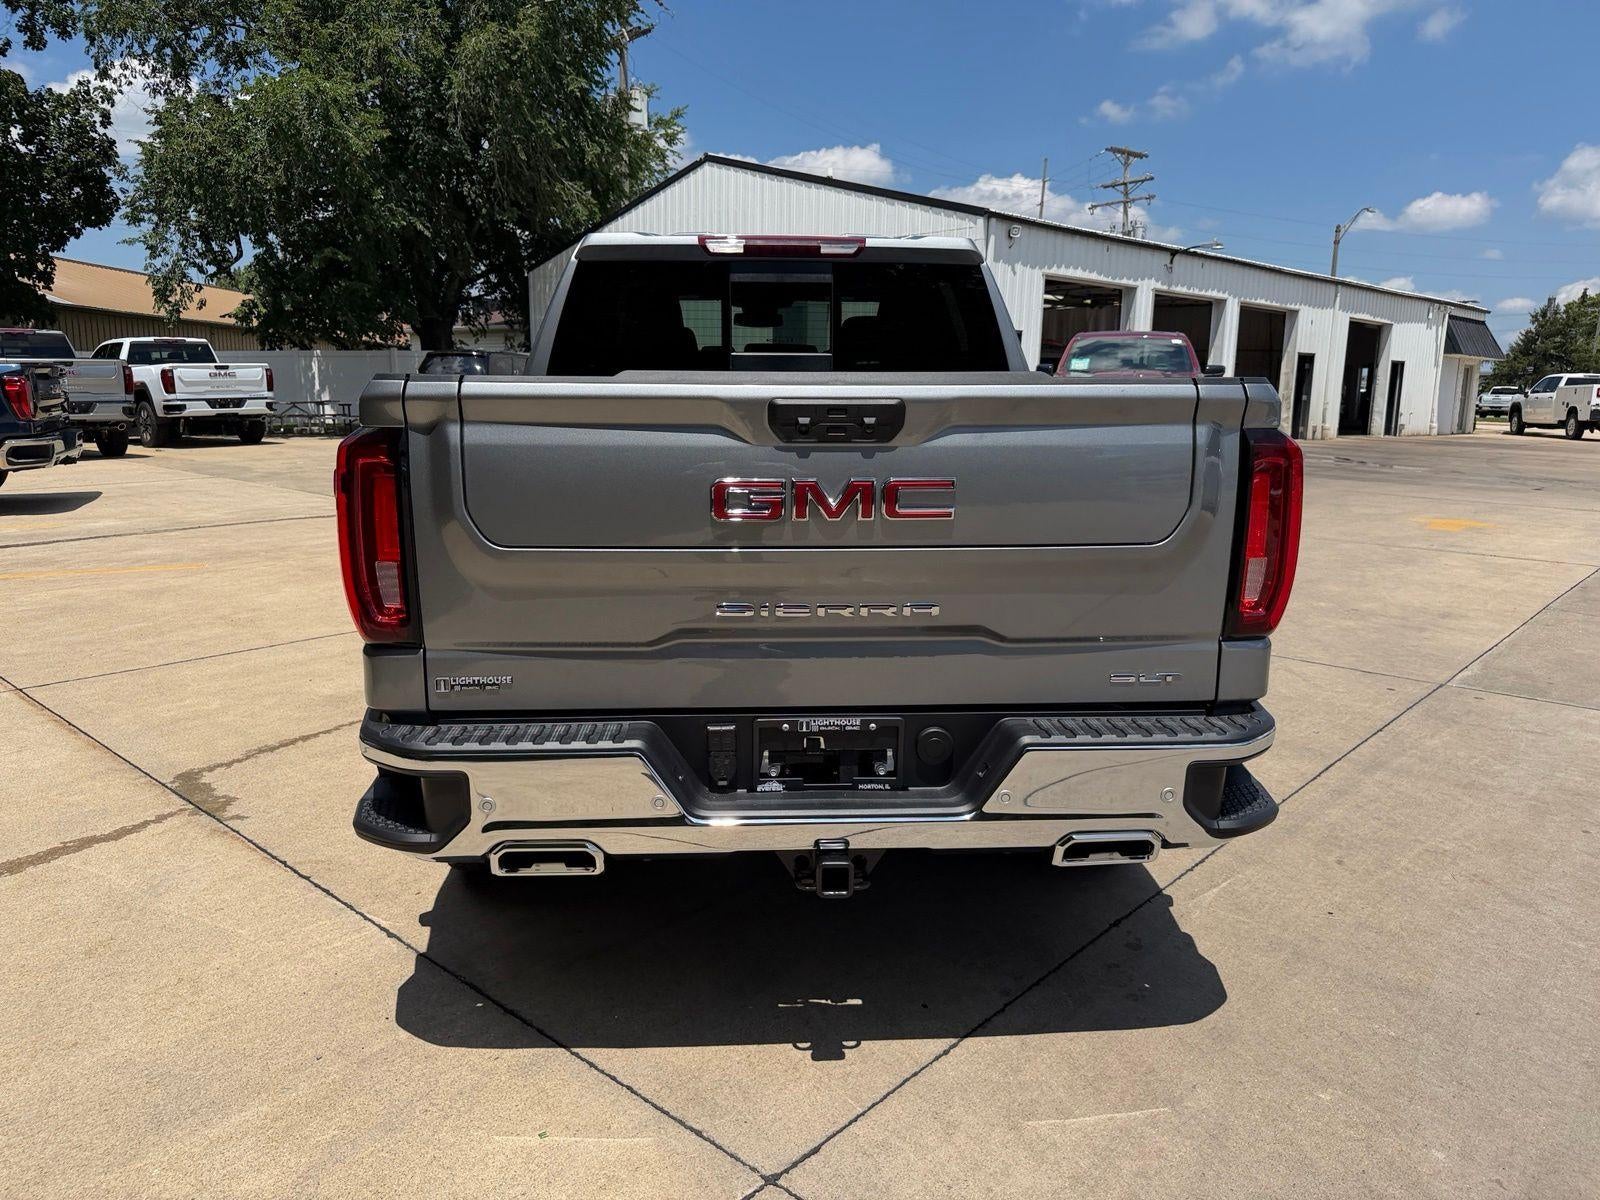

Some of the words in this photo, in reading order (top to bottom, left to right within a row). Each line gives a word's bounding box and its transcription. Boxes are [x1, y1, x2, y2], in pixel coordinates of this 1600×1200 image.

[711, 477, 956, 521] GMC
[715, 602, 940, 617] SIERRA
[450, 676, 513, 685] LIGHTHOUSE
[1110, 673, 1184, 683] SLT
